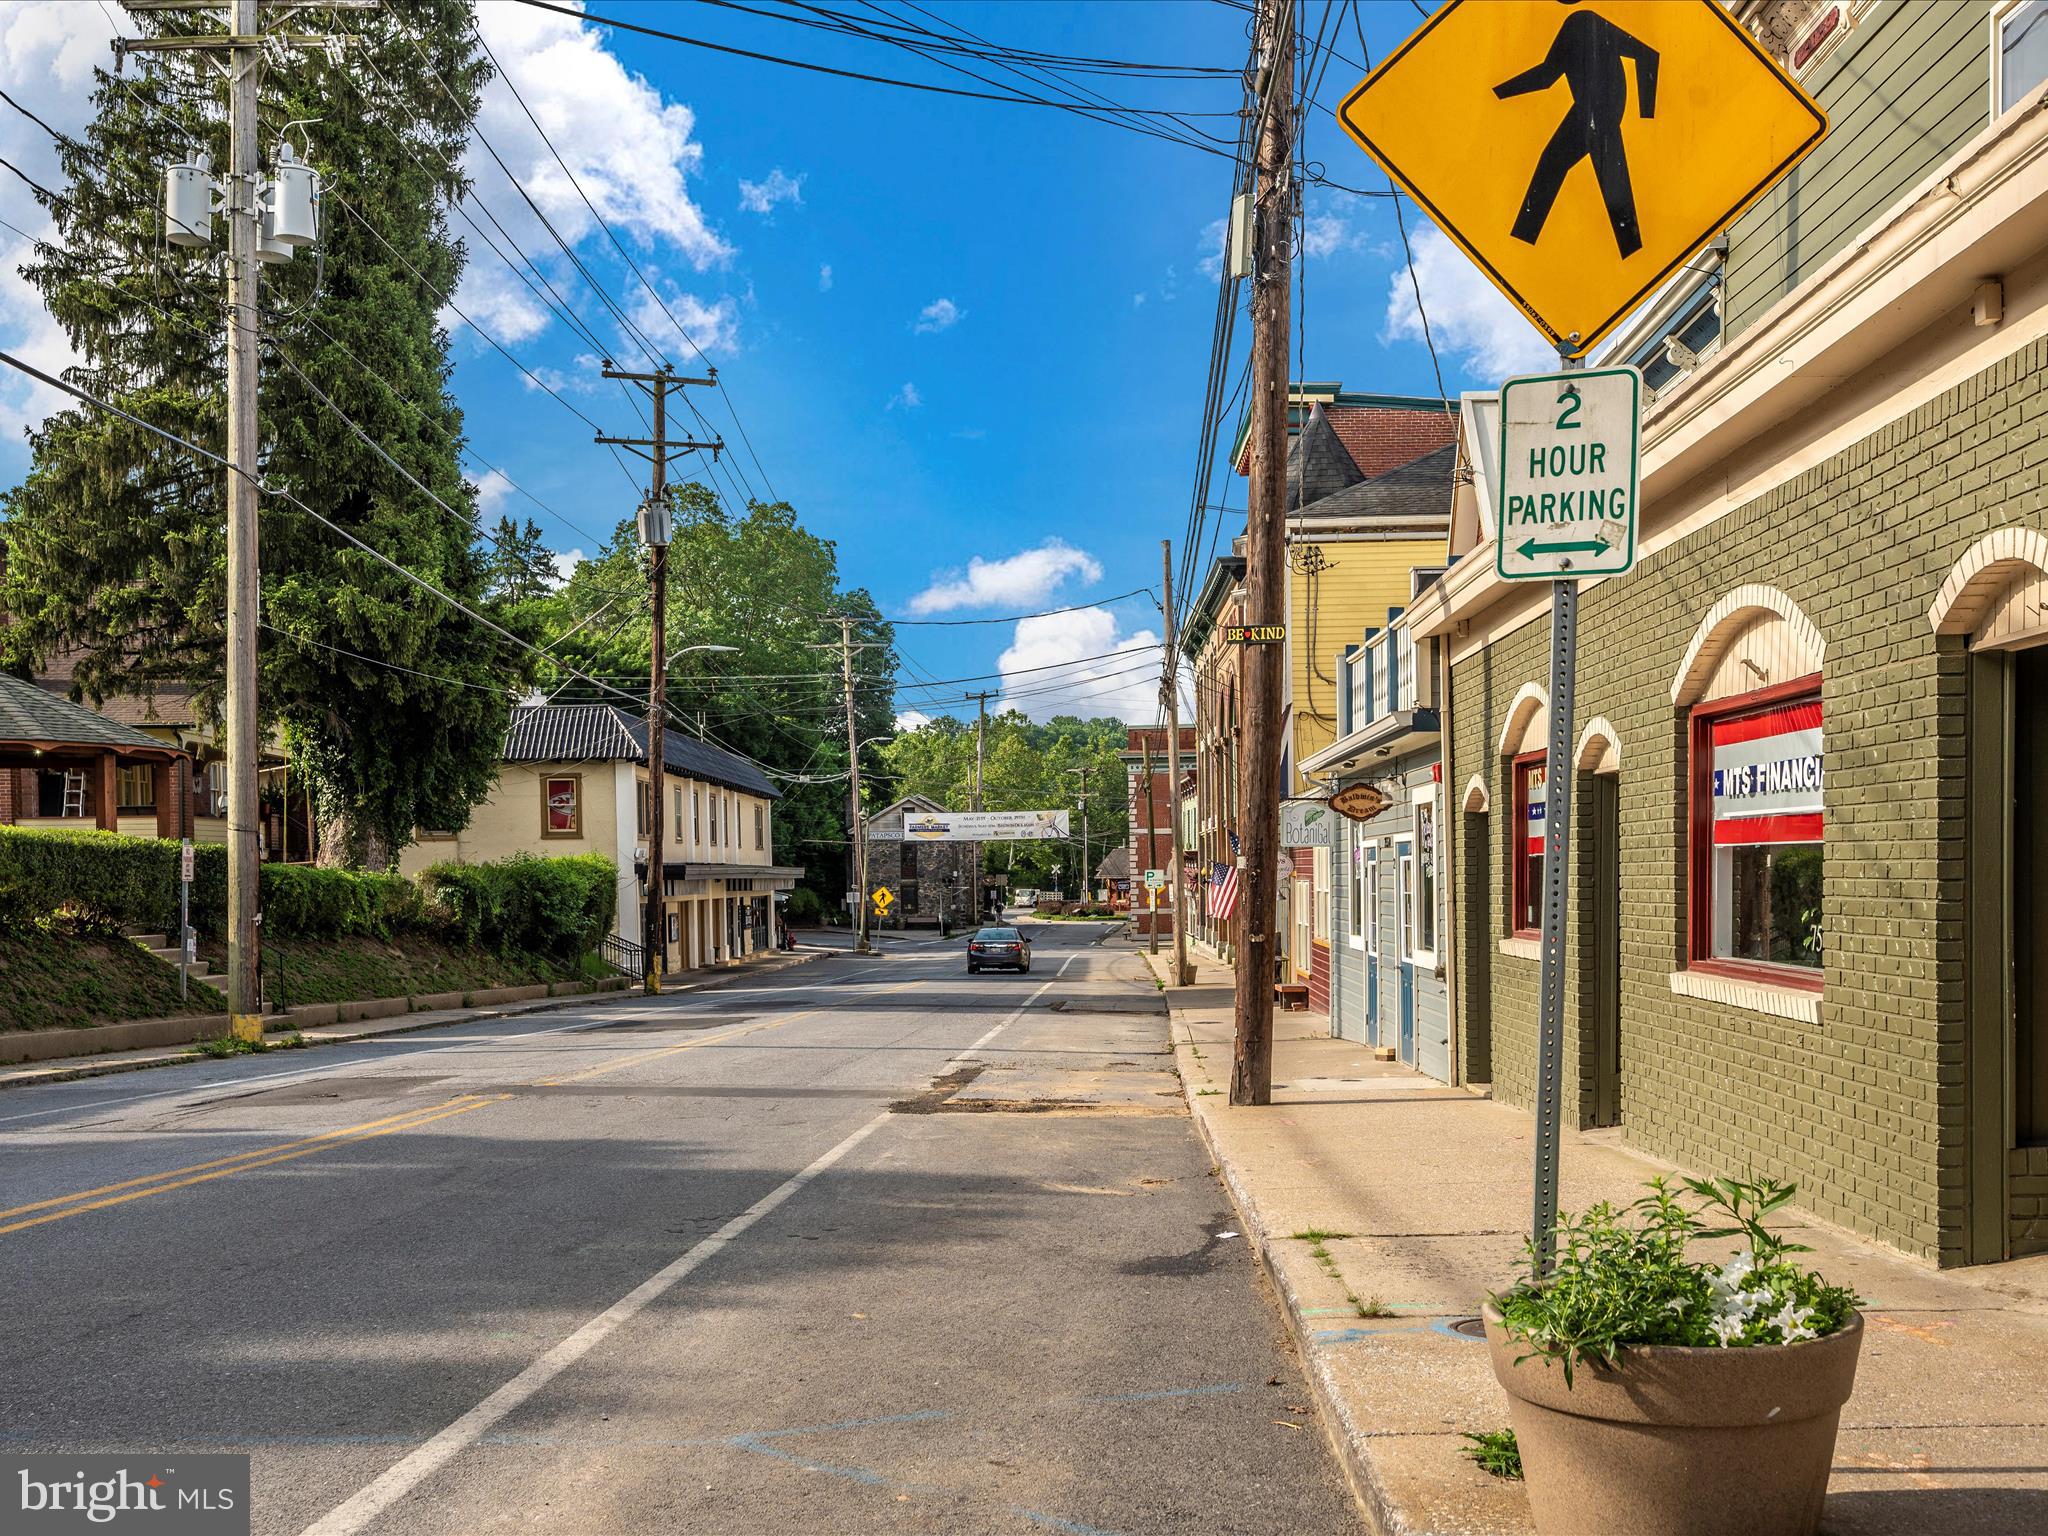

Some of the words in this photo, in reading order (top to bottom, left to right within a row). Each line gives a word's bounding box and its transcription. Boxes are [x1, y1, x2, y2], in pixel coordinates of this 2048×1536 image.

[1556, 393, 1582, 430] 2
[1529, 442, 1606, 479] HOUR
[1508, 487, 1626, 526] PARKING
[1227, 628, 1245, 641] BE
[1251, 626, 1285, 640] KIND
[1722, 765, 1751, 797] MTS
[1757, 756, 1825, 793] FINANCI
[1347, 804, 1377, 814] Dream
[1286, 821, 1331, 844] BotaniGal
